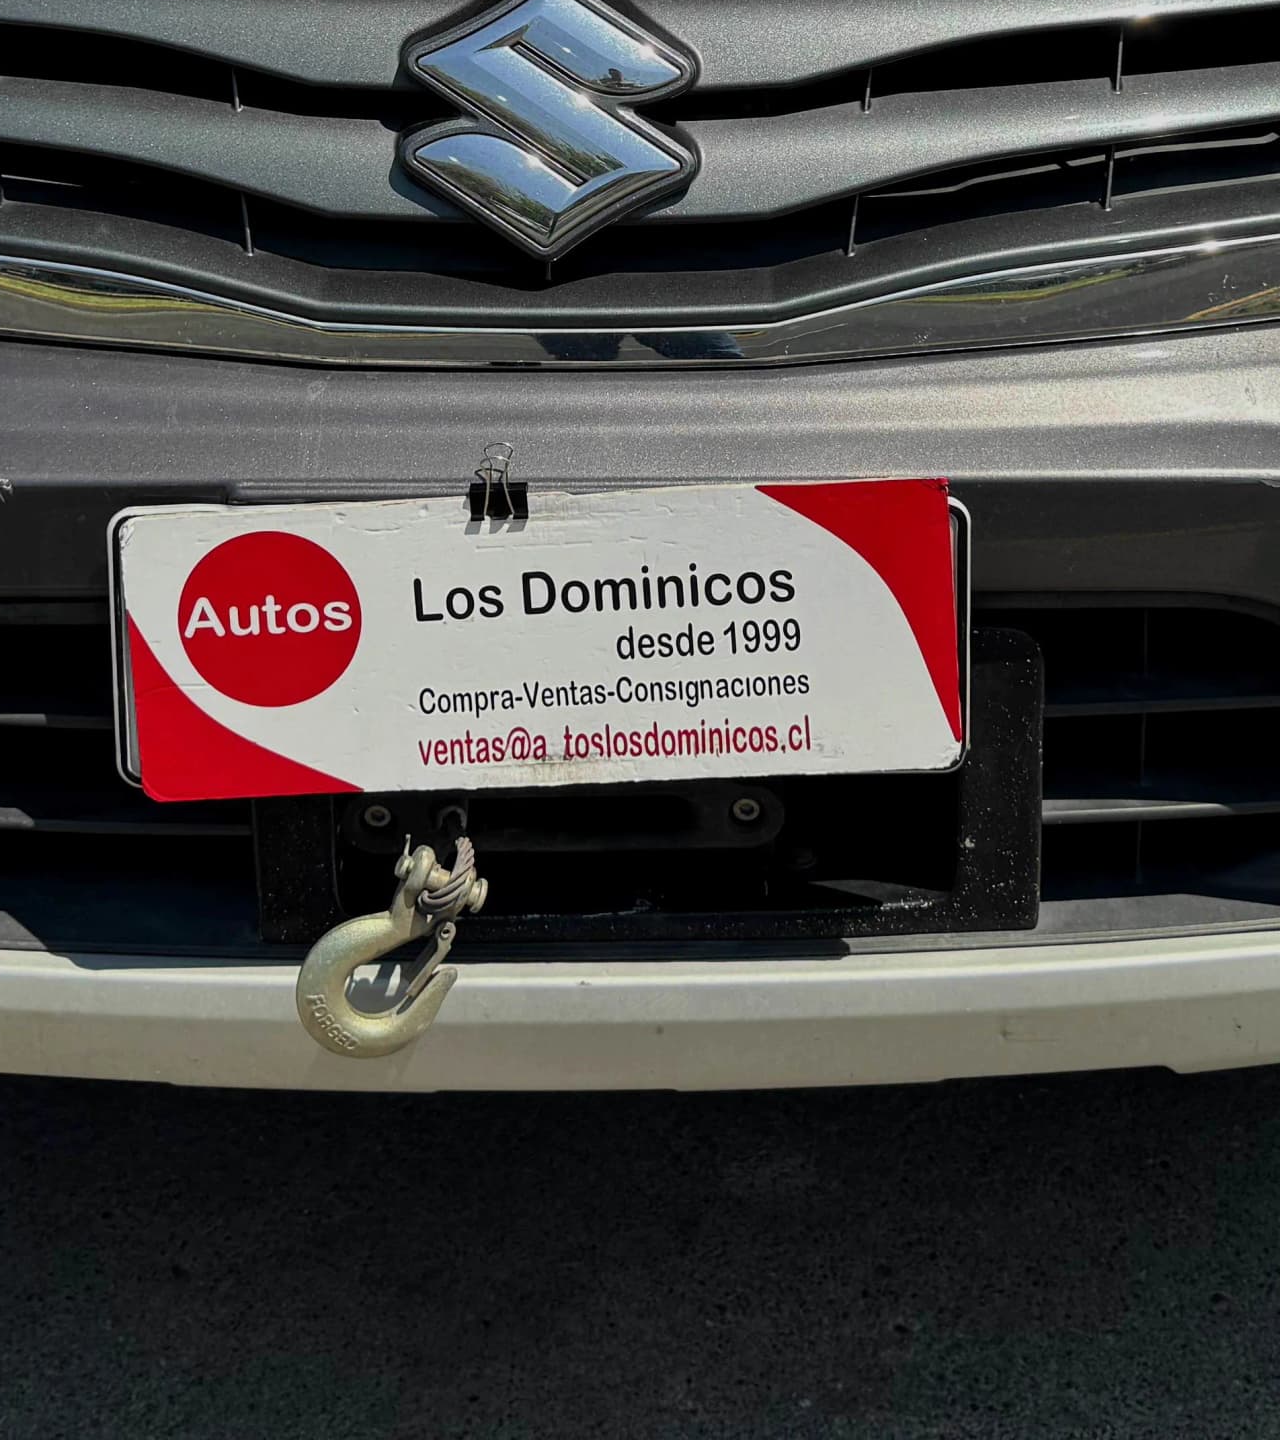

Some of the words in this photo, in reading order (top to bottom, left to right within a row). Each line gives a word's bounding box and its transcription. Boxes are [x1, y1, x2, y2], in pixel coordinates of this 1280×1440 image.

[184, 594, 353, 639] Autos
[413, 578, 504, 622] Los
[521, 563, 796, 615] Dominicos
[616, 622, 716, 660] desde
[722, 617, 802, 655] 1999
[418, 714, 812, 766] ventas@atoslosdominicos.cl
[306, 993, 359, 1050] FORGED
